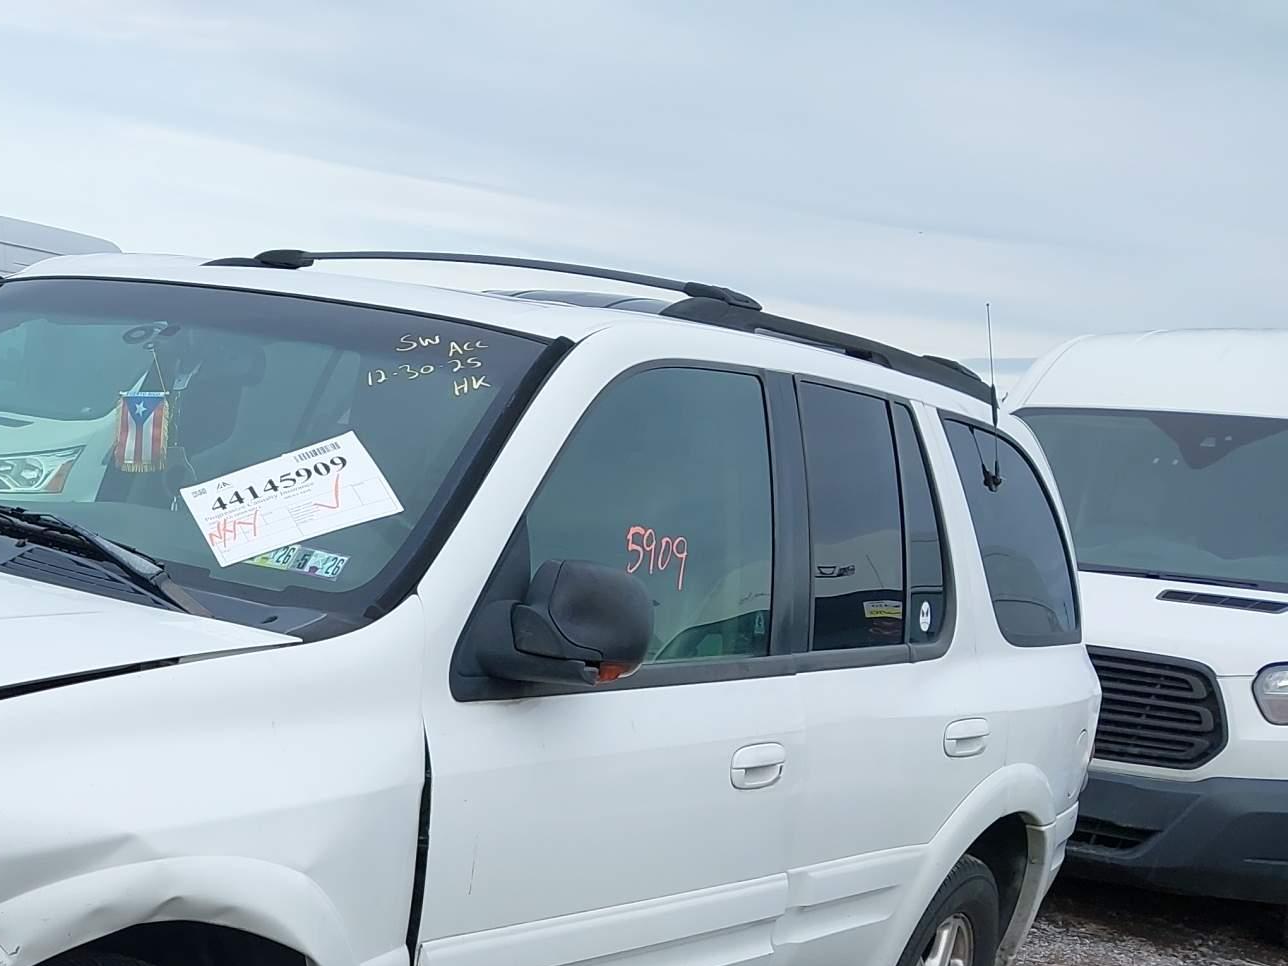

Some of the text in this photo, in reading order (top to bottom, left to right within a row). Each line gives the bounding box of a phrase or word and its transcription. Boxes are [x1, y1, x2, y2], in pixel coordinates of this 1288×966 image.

[396, 334, 440, 351] SW
[453, 375, 491, 396] HK
[211, 456, 348, 512] 44145909
[626, 526, 687, 591] 5909
